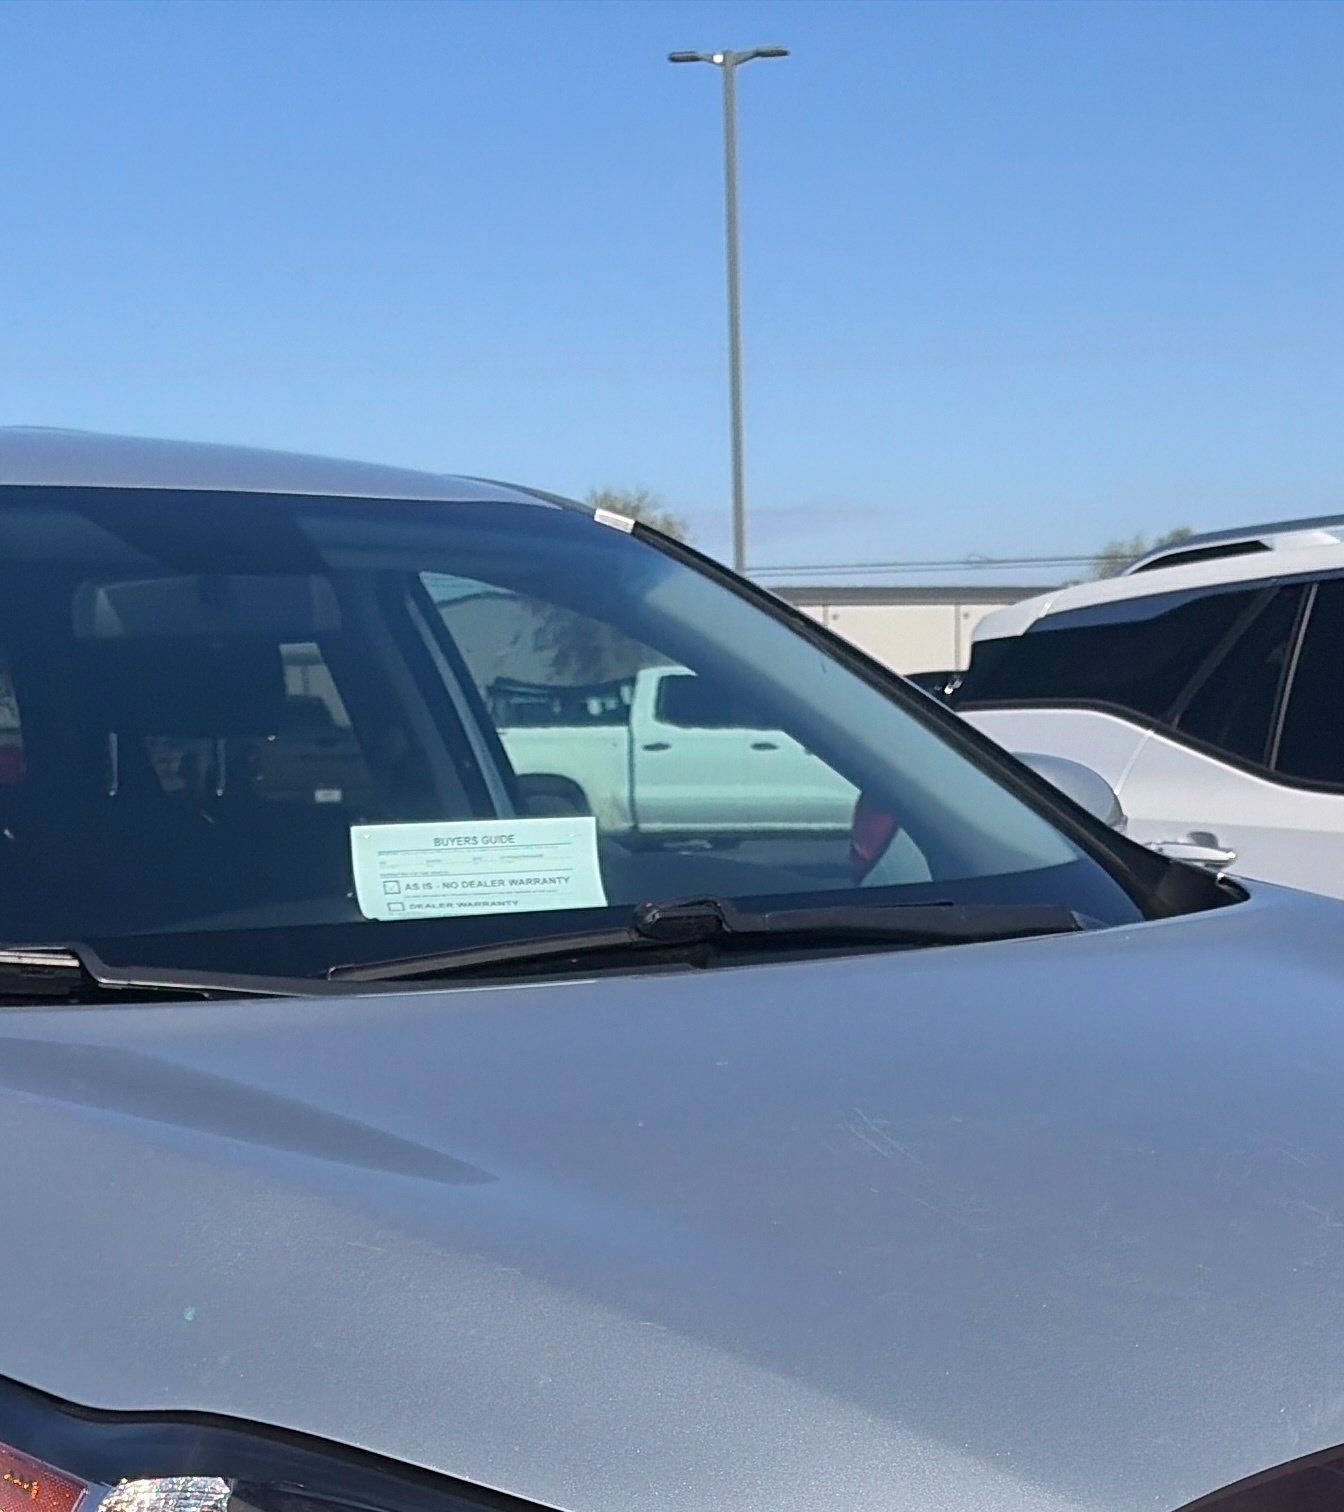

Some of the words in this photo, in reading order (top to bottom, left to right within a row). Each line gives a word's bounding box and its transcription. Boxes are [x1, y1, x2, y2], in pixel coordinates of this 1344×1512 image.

[433, 835, 479, 847] BUYERS
[481, 834, 516, 846] GUIDE
[404, 882, 420, 891] AS
[422, 882, 433, 891] IS
[442, 881, 460, 890] NO
[461, 878, 506, 889] DEALER
[508, 876, 571, 887] WARRANTY
[408, 901, 454, 910] DEALER
[455, 900, 519, 909] WARRANTY
